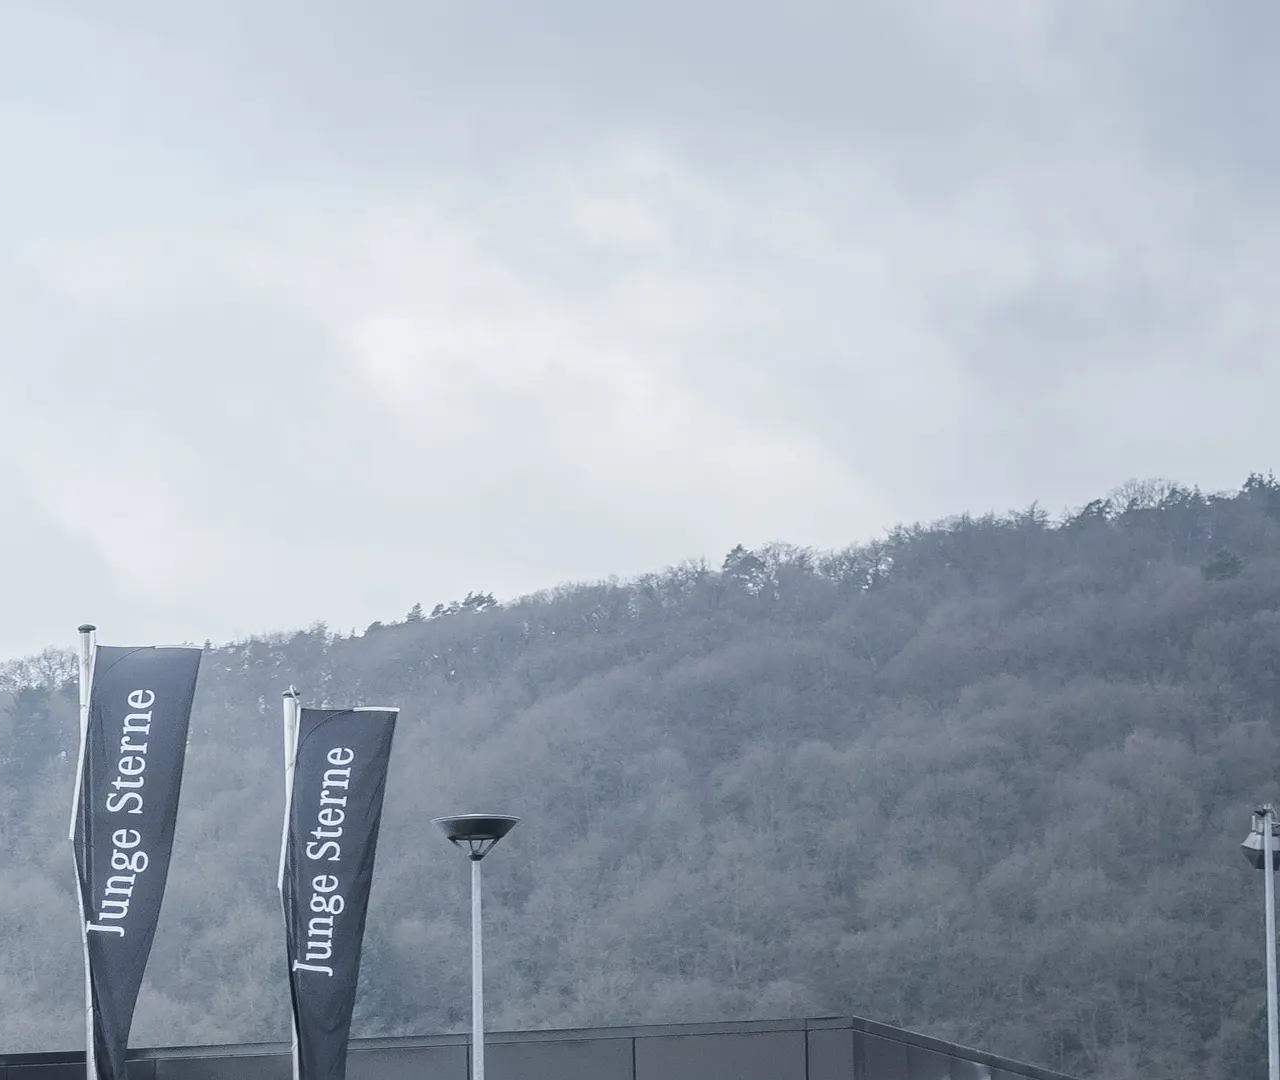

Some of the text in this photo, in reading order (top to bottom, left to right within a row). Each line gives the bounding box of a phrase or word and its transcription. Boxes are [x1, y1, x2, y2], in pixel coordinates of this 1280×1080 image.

[86, 689, 155, 937] Junge Sterne
[293, 747, 354, 977] Junge Sterne
